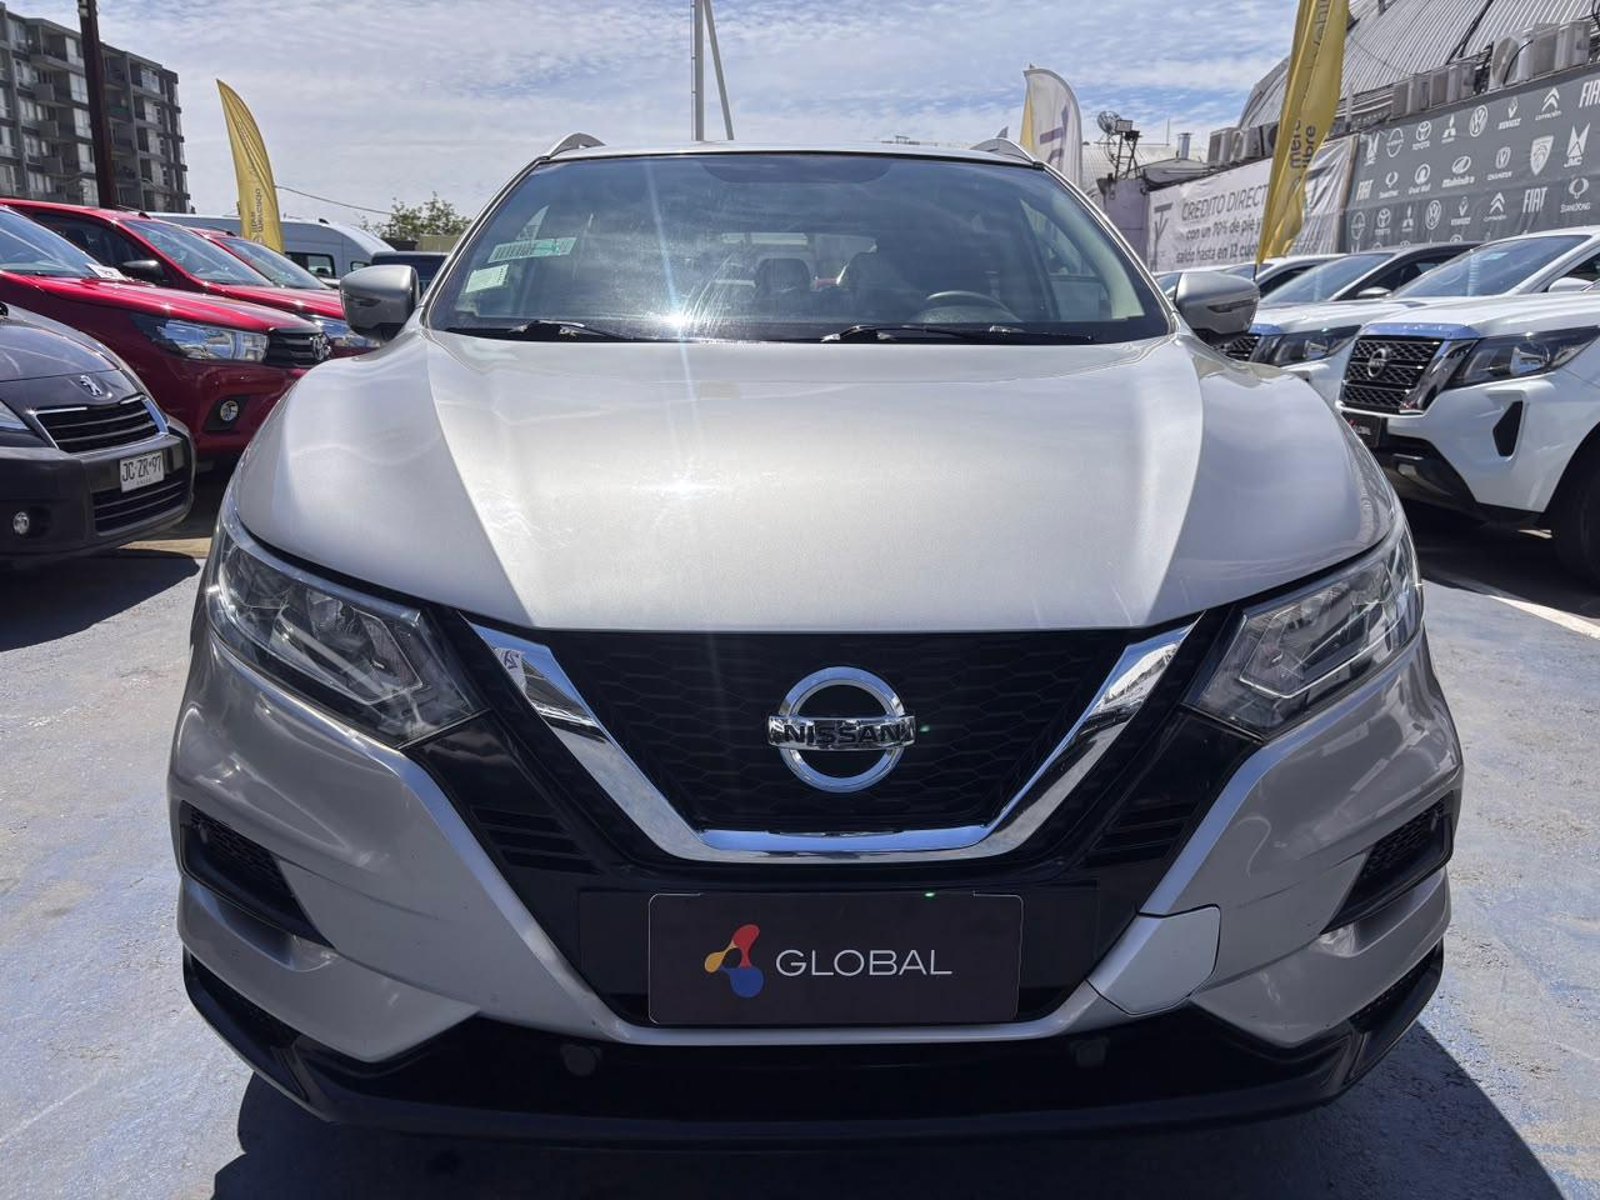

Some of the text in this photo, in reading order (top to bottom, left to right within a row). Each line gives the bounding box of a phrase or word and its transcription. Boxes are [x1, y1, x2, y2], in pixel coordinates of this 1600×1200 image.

[1579, 80, 1600, 108] FIA
[1523, 186, 1548, 214] FIAT
[783, 722, 902, 746] NISSAN
[776, 949, 953, 977] GLOBAL
